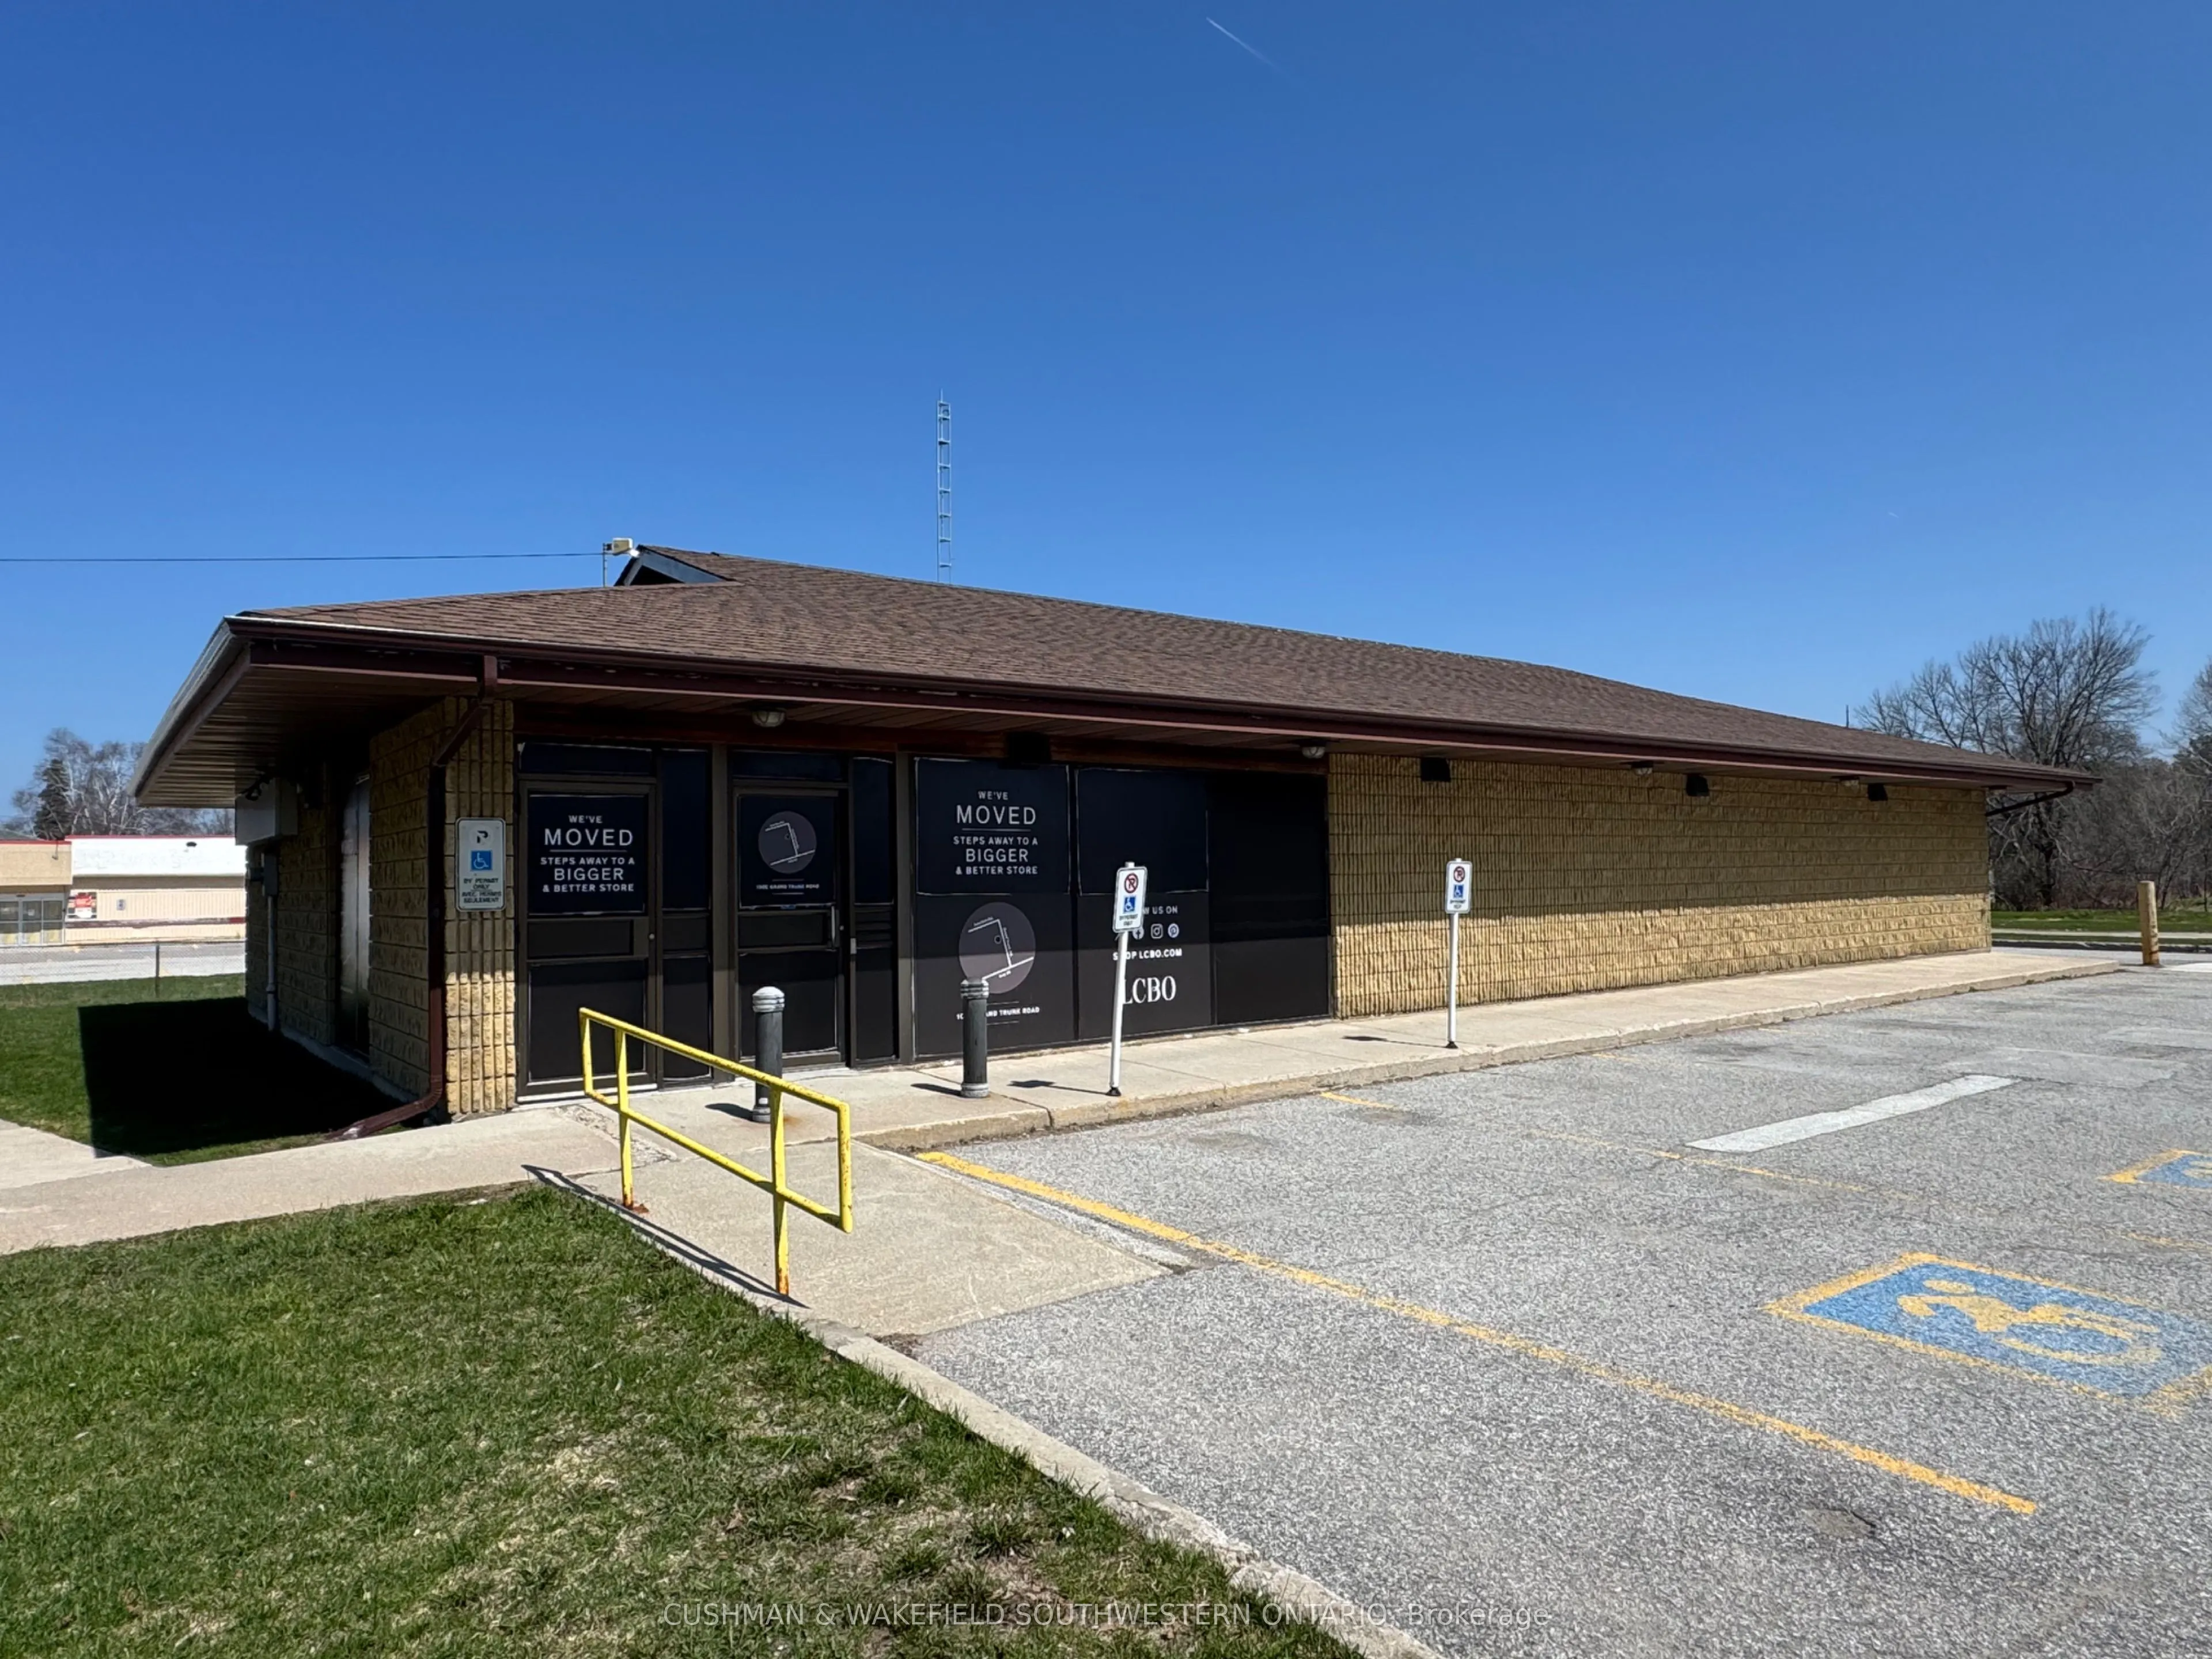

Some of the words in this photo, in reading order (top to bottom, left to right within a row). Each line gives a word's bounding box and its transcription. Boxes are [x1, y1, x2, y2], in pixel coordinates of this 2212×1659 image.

[978, 791, 1008, 800] WE'VE
[569, 815, 603, 823] WE'VE
[956, 805, 1036, 824] MOVED
[544, 828, 633, 846] MOVED
[953, 836, 986, 845] STEPS
[988, 836, 1014, 845] AWAY
[1017, 836, 1029, 845] TO
[1032, 837, 1038, 846] A
[966, 849, 1028, 862] BIGGER
[554, 868, 624, 881] BIGGER
[956, 866, 963, 875] &
[966, 866, 1003, 874] BETTER
[1007, 866, 1038, 874] STORE
[554, 884, 596, 892] BETTER
[599, 884, 634, 892] STORE
[1152, 906, 1164, 914] US
[1166, 905, 1178, 914] ON
[1112, 951, 1137, 961] SOP
[1139, 948, 1182, 959] LCBO.COM
